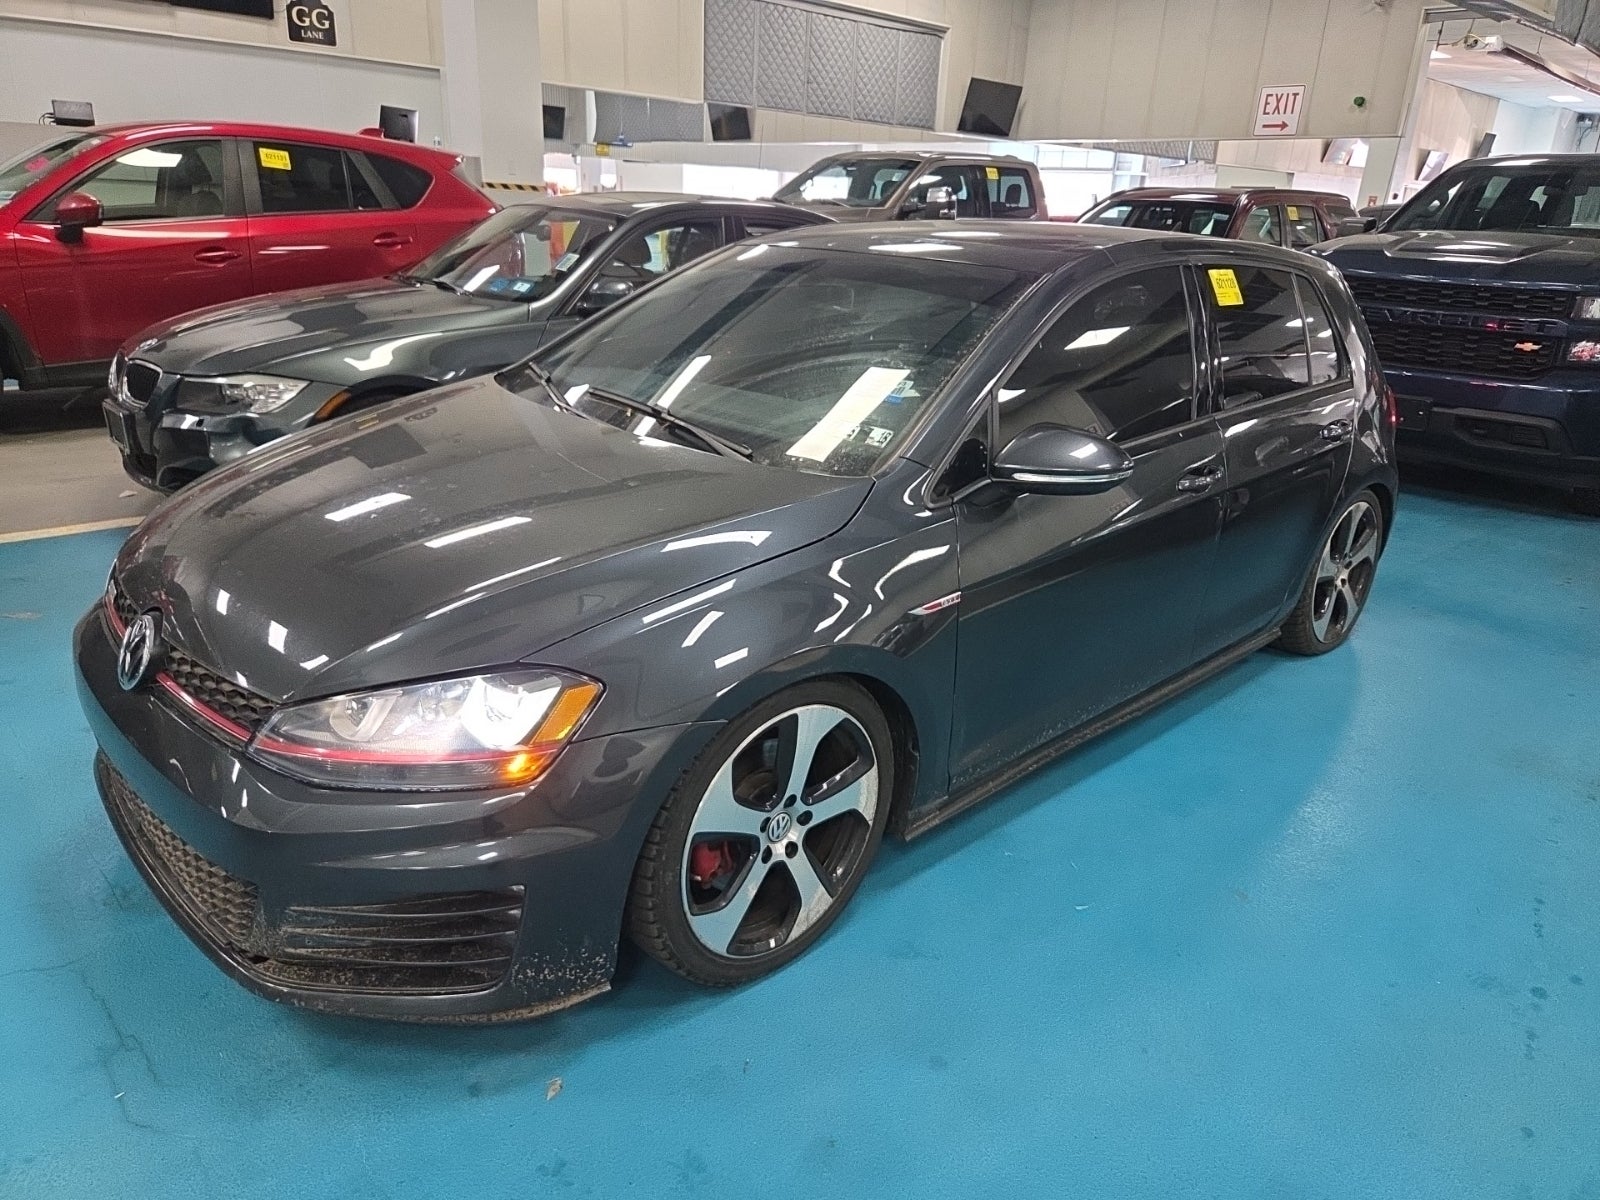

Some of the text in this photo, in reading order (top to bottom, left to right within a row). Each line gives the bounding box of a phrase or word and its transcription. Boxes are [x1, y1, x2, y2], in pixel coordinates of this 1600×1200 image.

[291, 5, 330, 29] GG
[301, 29, 324, 40] LANE
[1262, 92, 1300, 115] EXIT
